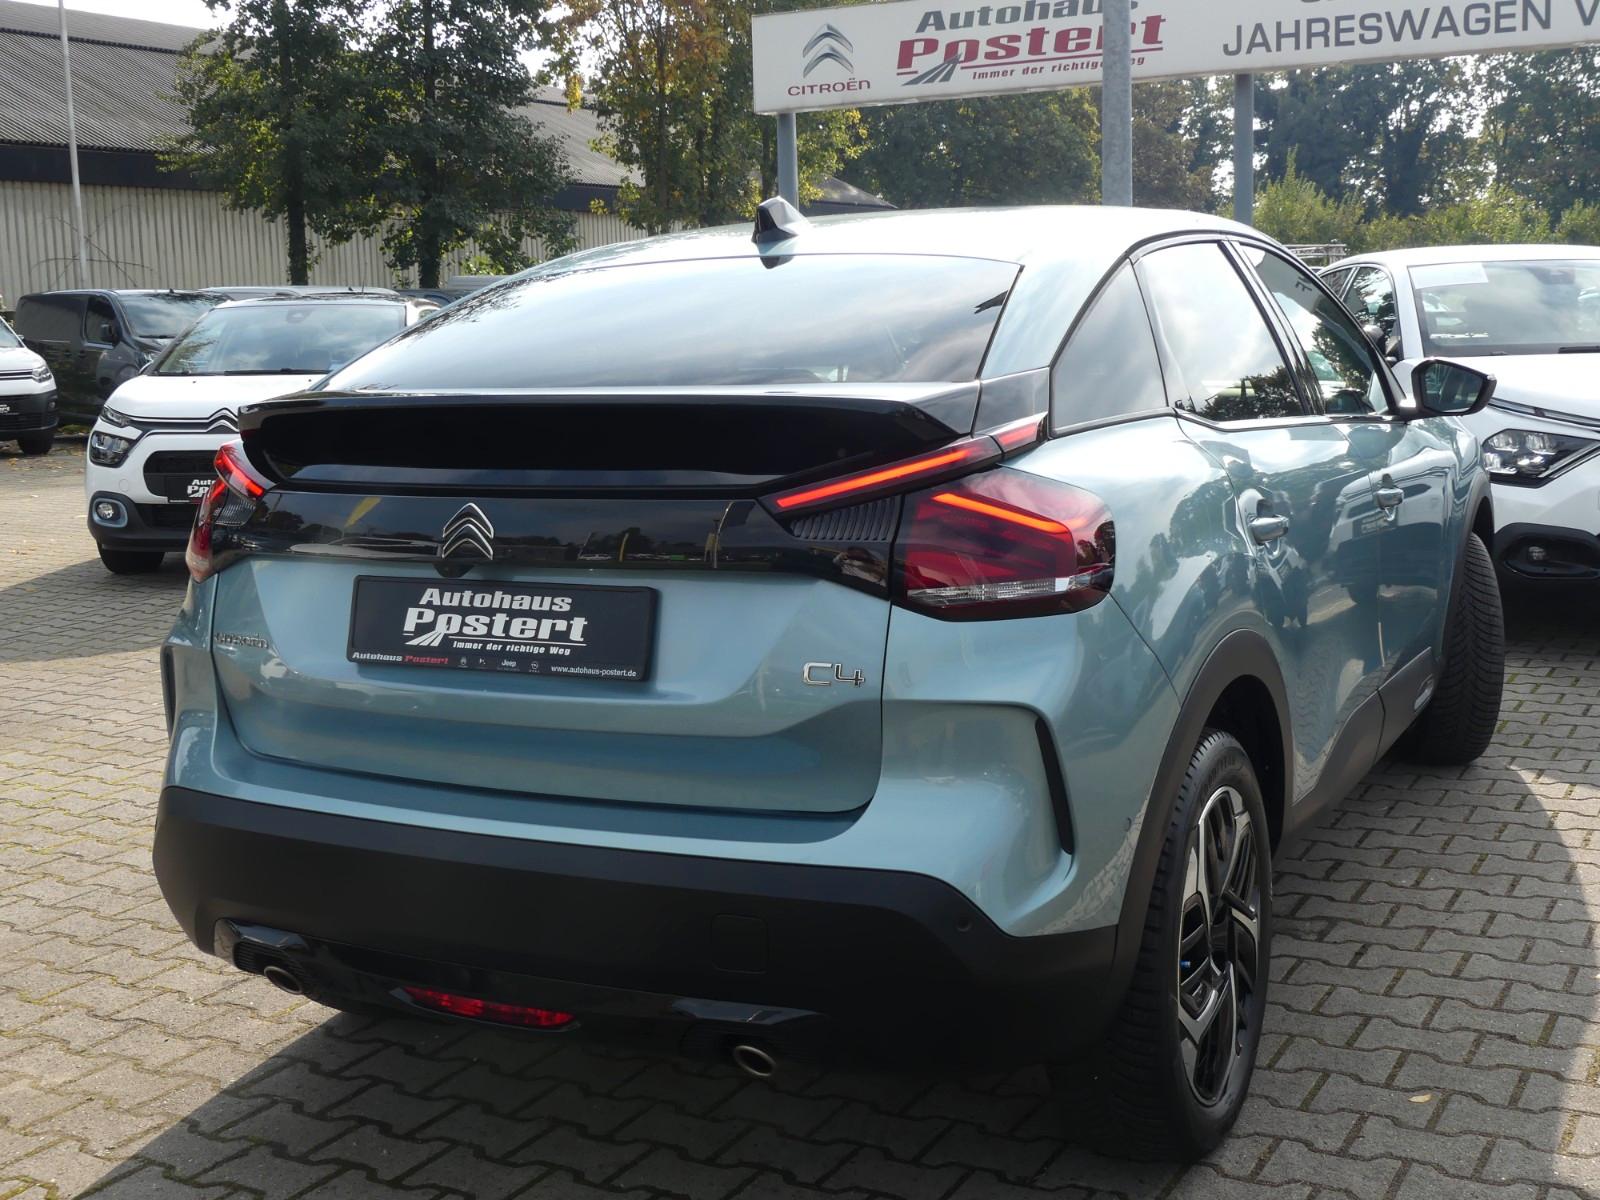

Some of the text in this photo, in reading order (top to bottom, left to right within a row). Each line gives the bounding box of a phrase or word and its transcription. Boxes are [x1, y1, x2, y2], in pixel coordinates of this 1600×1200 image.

[915, 0, 1138, 33] Autohau
[1223, 0, 1551, 57] JAHRESWAGEN
[896, 15, 1166, 68] Postet
[972, 68, 1015, 80] Immer
[1022, 65, 1044, 75] der
[419, 588, 573, 612] Autohaus
[403, 607, 588, 642] Postert
[352, 651, 449, 665] Autohaus Postert
[453, 640, 571, 656] Immer der richtige Weg
[501, 659, 517, 668] Jeep
[550, 665, 637, 677] www.autohaus-postert.de
[803, 662, 865, 687] C4
